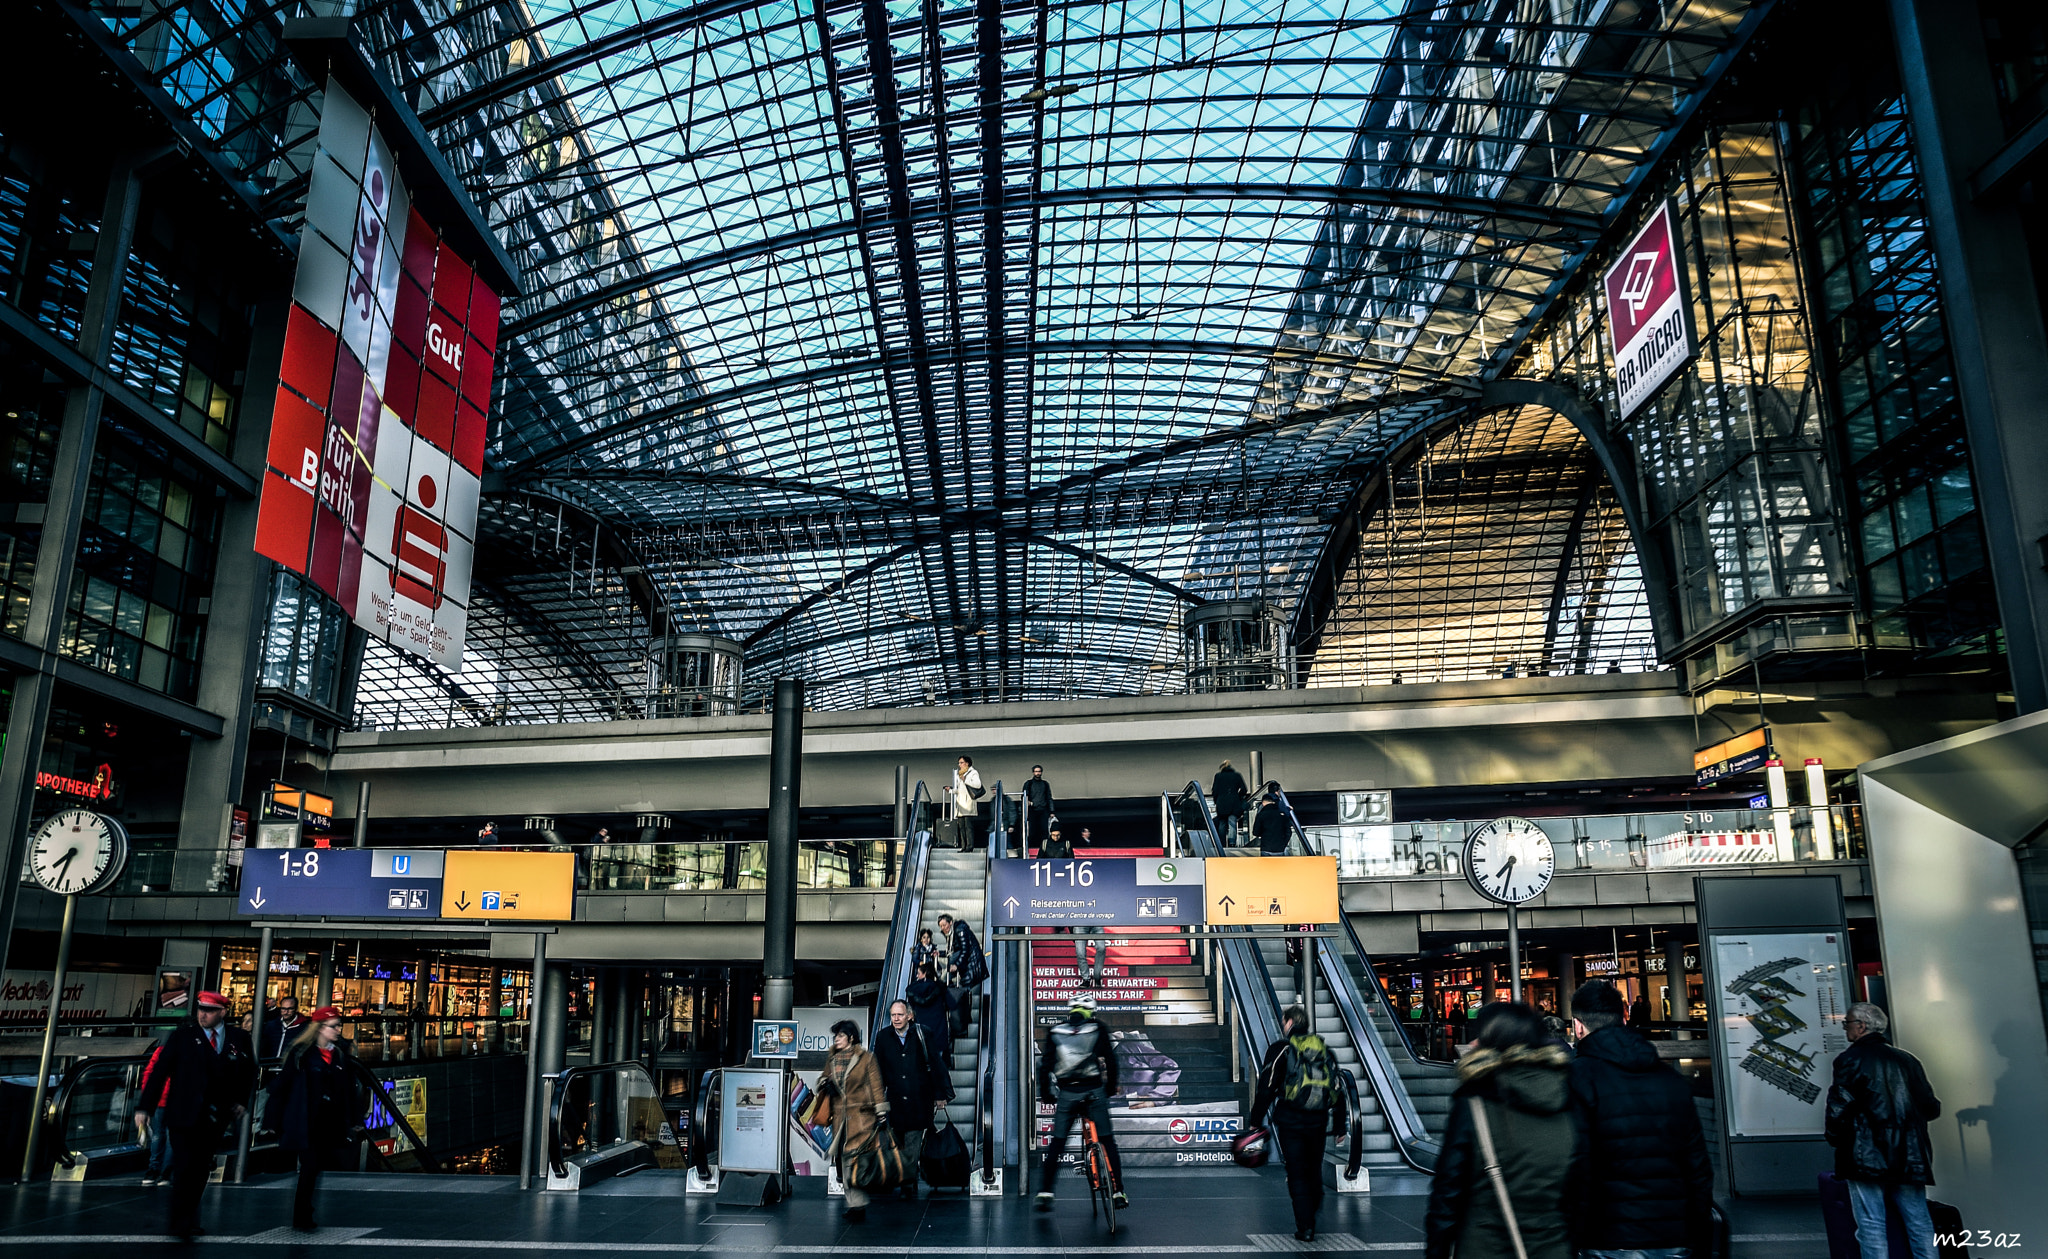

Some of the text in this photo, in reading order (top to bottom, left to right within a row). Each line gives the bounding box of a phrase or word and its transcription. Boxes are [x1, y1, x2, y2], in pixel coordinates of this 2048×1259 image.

[428, 322, 463, 372] Gut
[326, 424, 351, 476] für
[300, 447, 355, 527] Berlin
[400, 610, 412, 624] um
[414, 615, 431, 632] Geld
[375, 611, 446, 654] Berliner Sparkasse
[36, 771, 99, 799] APOTHEKE
[1684, 813, 1693, 824] S
[279, 851, 319, 877] 1-8
[394, 856, 409, 874] U
[1160, 863, 1174, 882] S
[1029, 861, 1094, 888] 11-16
[1030, 899, 1096, 908] Reisezentrum +1
[1036, 967, 1056, 976] WER
[1057, 967, 1076, 976] VIEL
[1585, 960, 1617, 972] SAMOON
[1644, 959, 1658, 971] THE
[1036, 979, 1059, 987] DARF
[1107, 979, 1157, 987] ERWARTEN:
[1036, 991, 1054, 999] DEN
[1119, 990, 1146, 999] TARIF.
[1194, 1119, 1239, 1143] HRS
[1176, 1152, 1194, 1162] Das
